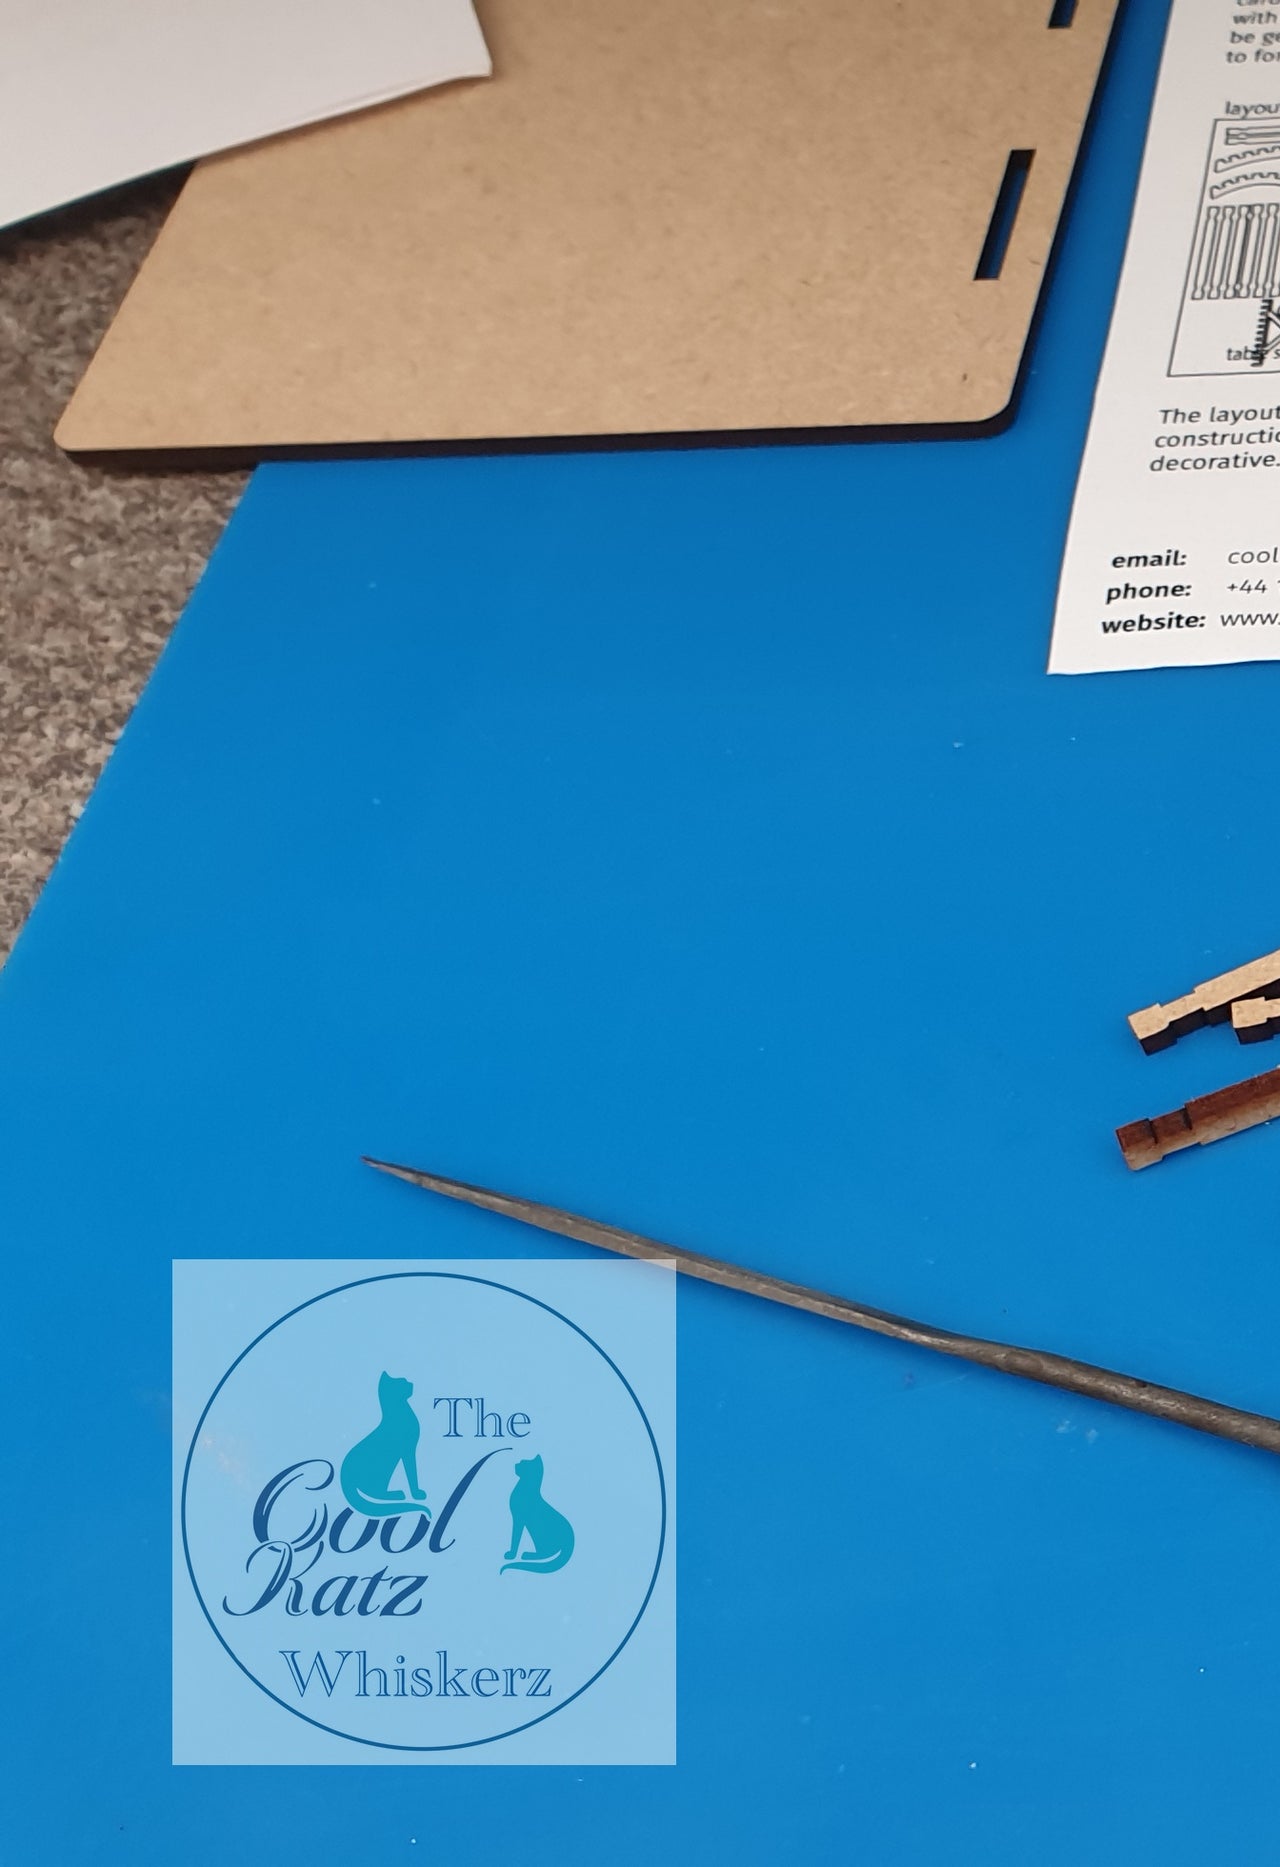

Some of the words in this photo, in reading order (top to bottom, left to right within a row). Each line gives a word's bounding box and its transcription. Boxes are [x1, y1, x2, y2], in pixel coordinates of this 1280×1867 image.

[1232, 11, 1277, 25] with
[1229, 30, 1256, 44] be
[1225, 50, 1247, 64] to
[1226, 346, 1267, 361] tab
[1159, 407, 1201, 425] The
[1111, 549, 1187, 568] email:
[1105, 583, 1192, 605] phone:
[1226, 579, 1268, 594] +44
[1101, 611, 1206, 634] website:
